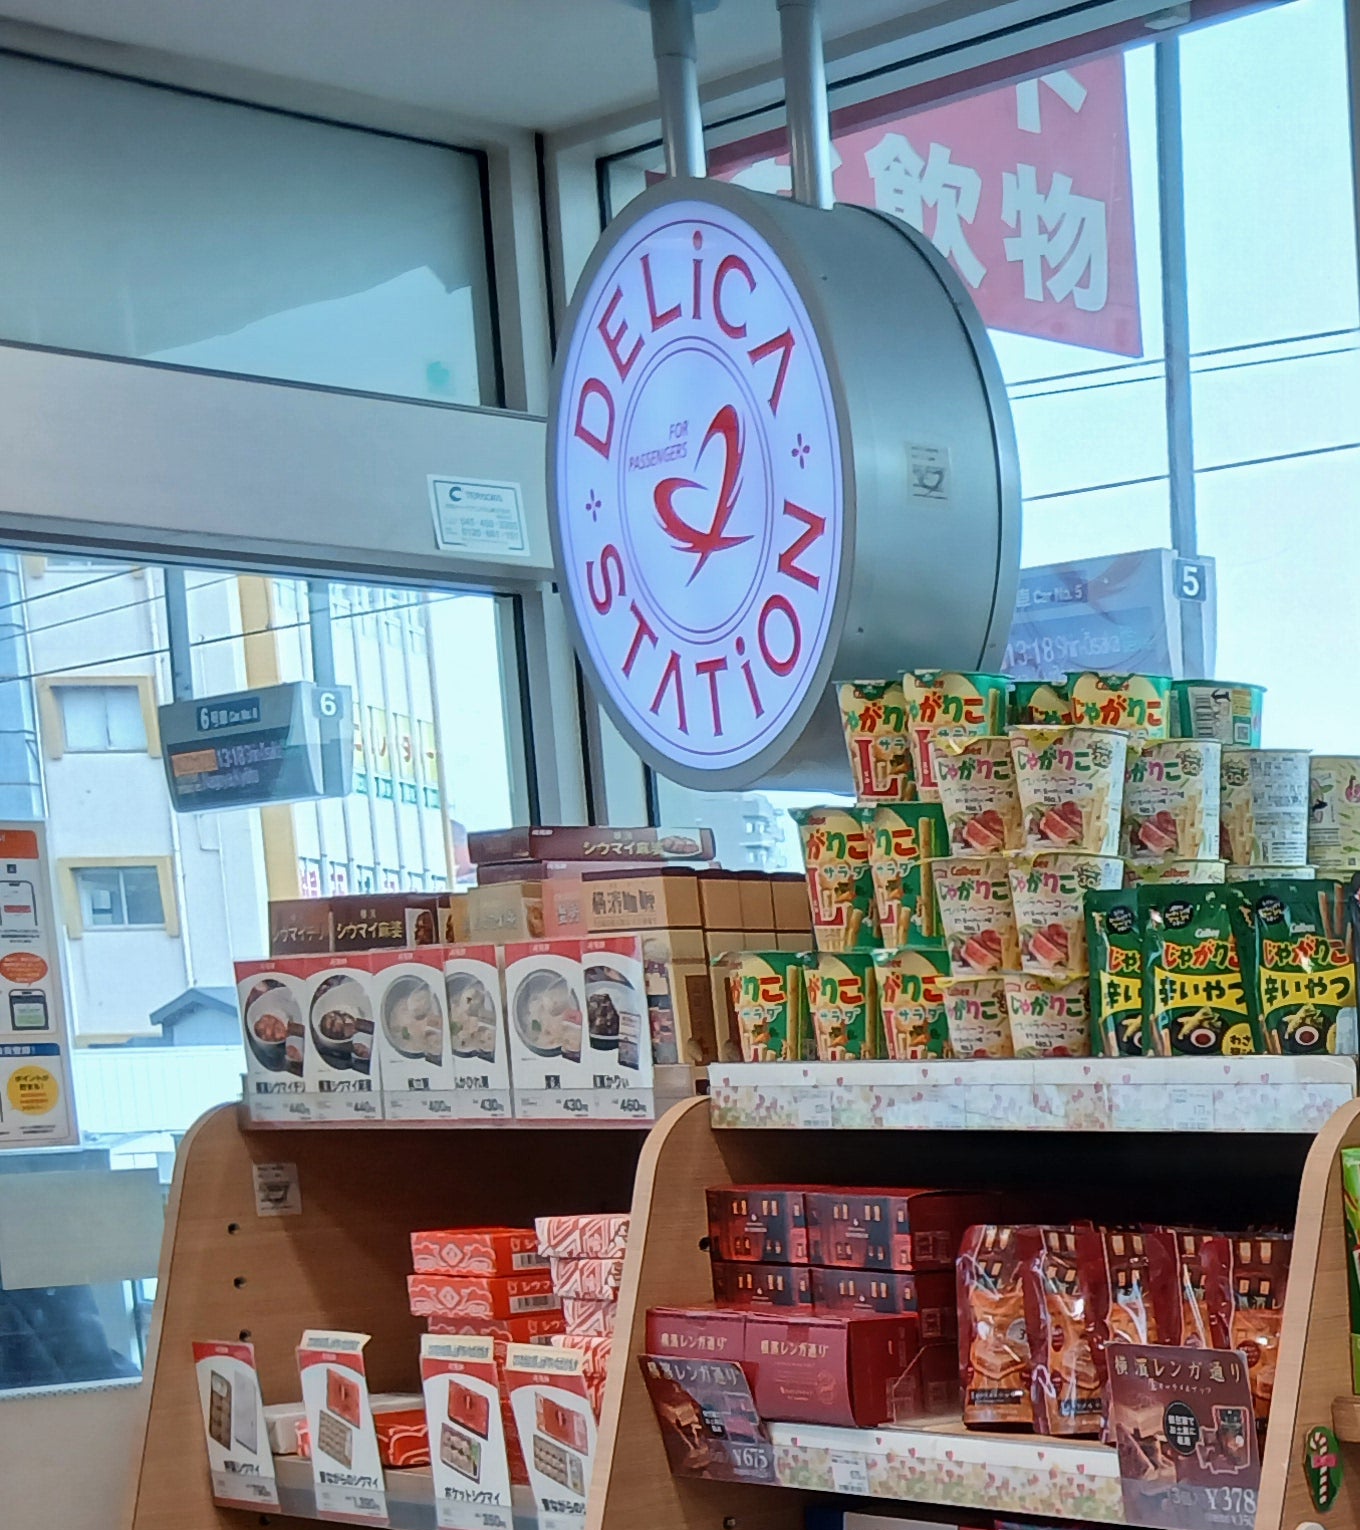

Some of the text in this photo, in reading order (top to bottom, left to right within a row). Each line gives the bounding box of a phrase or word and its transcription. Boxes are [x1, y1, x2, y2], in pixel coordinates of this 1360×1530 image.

[668, 420, 689, 440] FOR
[628, 442, 688, 472] PASSENGERS
[1074, 586, 1083, 599] 5
[1182, 566, 1200, 597] 5
[320, 692, 336, 716] 6
[1017, 746, 1093, 772] じゃがりこ
[1263, 939, 1350, 973] じゃがりこ
[1263, 973, 1351, 1003] 辛いやつ
